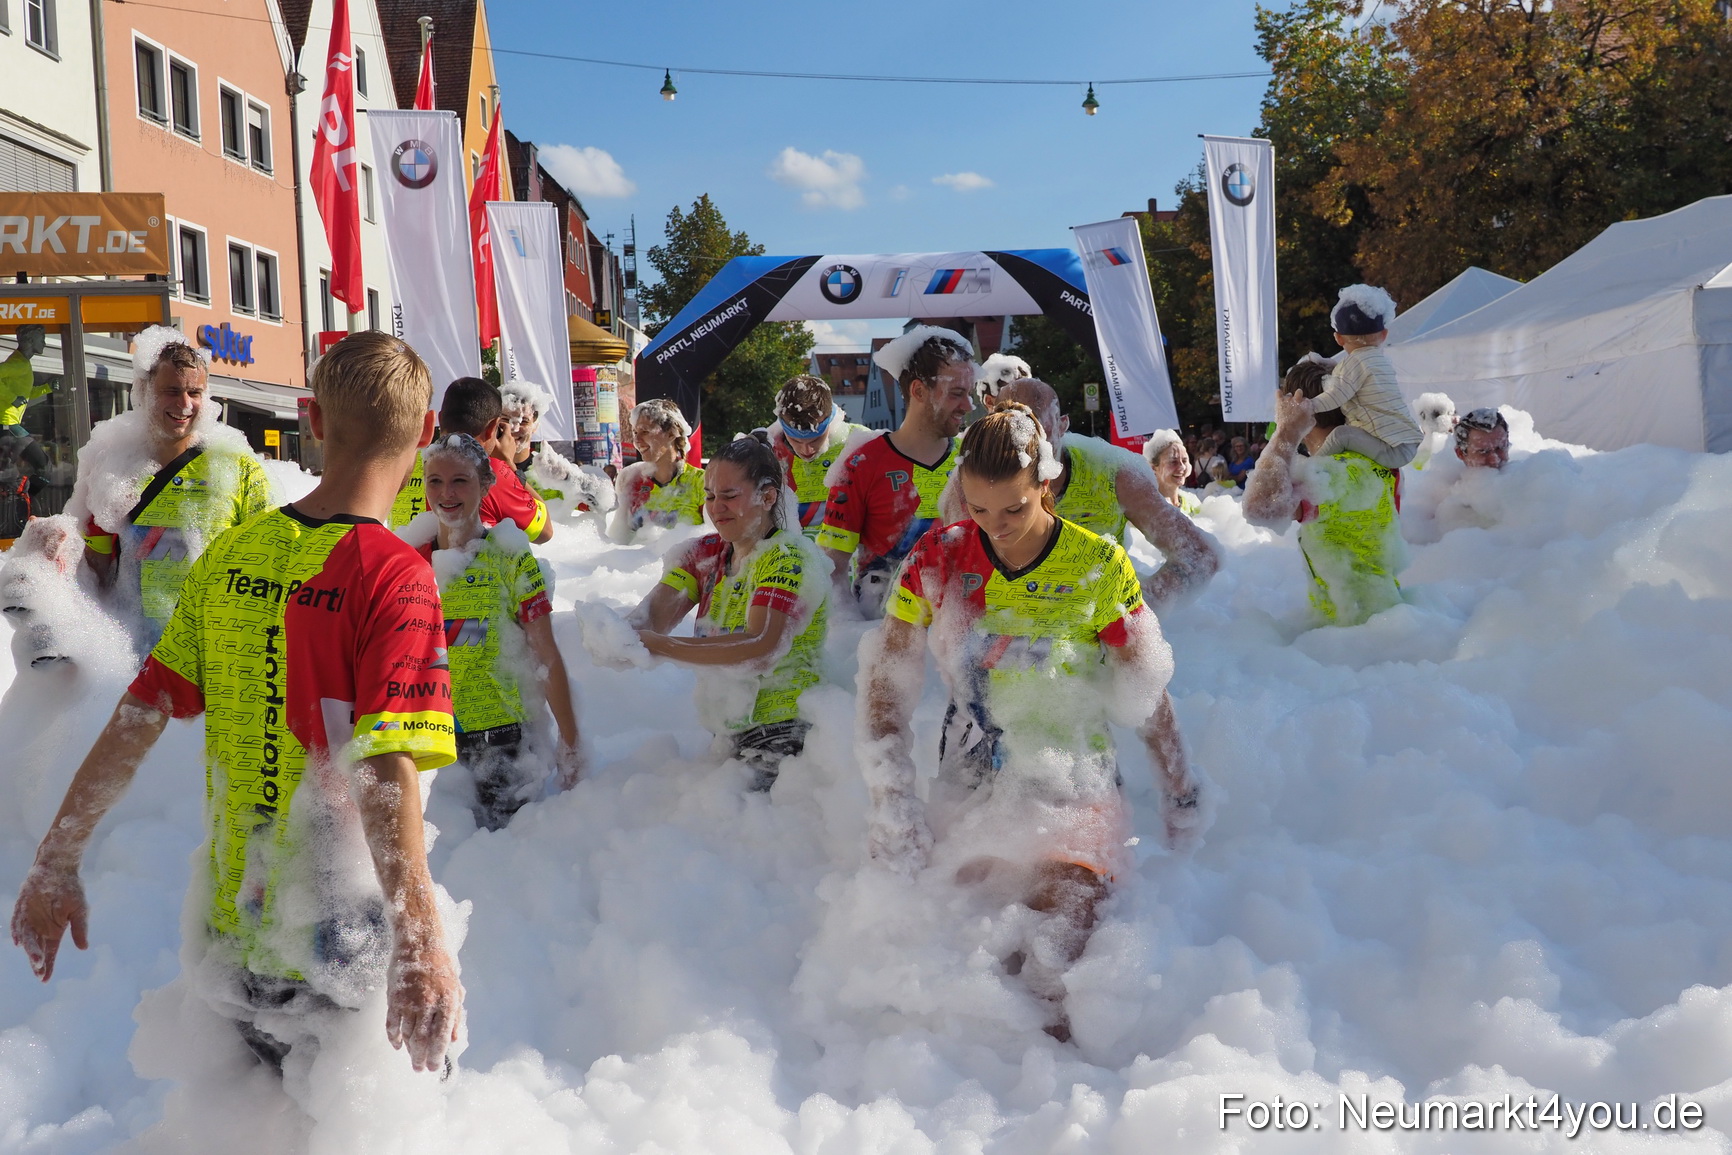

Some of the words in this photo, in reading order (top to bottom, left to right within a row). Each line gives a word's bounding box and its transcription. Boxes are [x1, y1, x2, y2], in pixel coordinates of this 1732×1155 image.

[656, 338, 692, 365] PARTL
[690, 297, 748, 342] NEUMARKT
[284, 579, 347, 613] Partl
[386, 680, 437, 699] BMW
[403, 720, 455, 736] Motorsp
